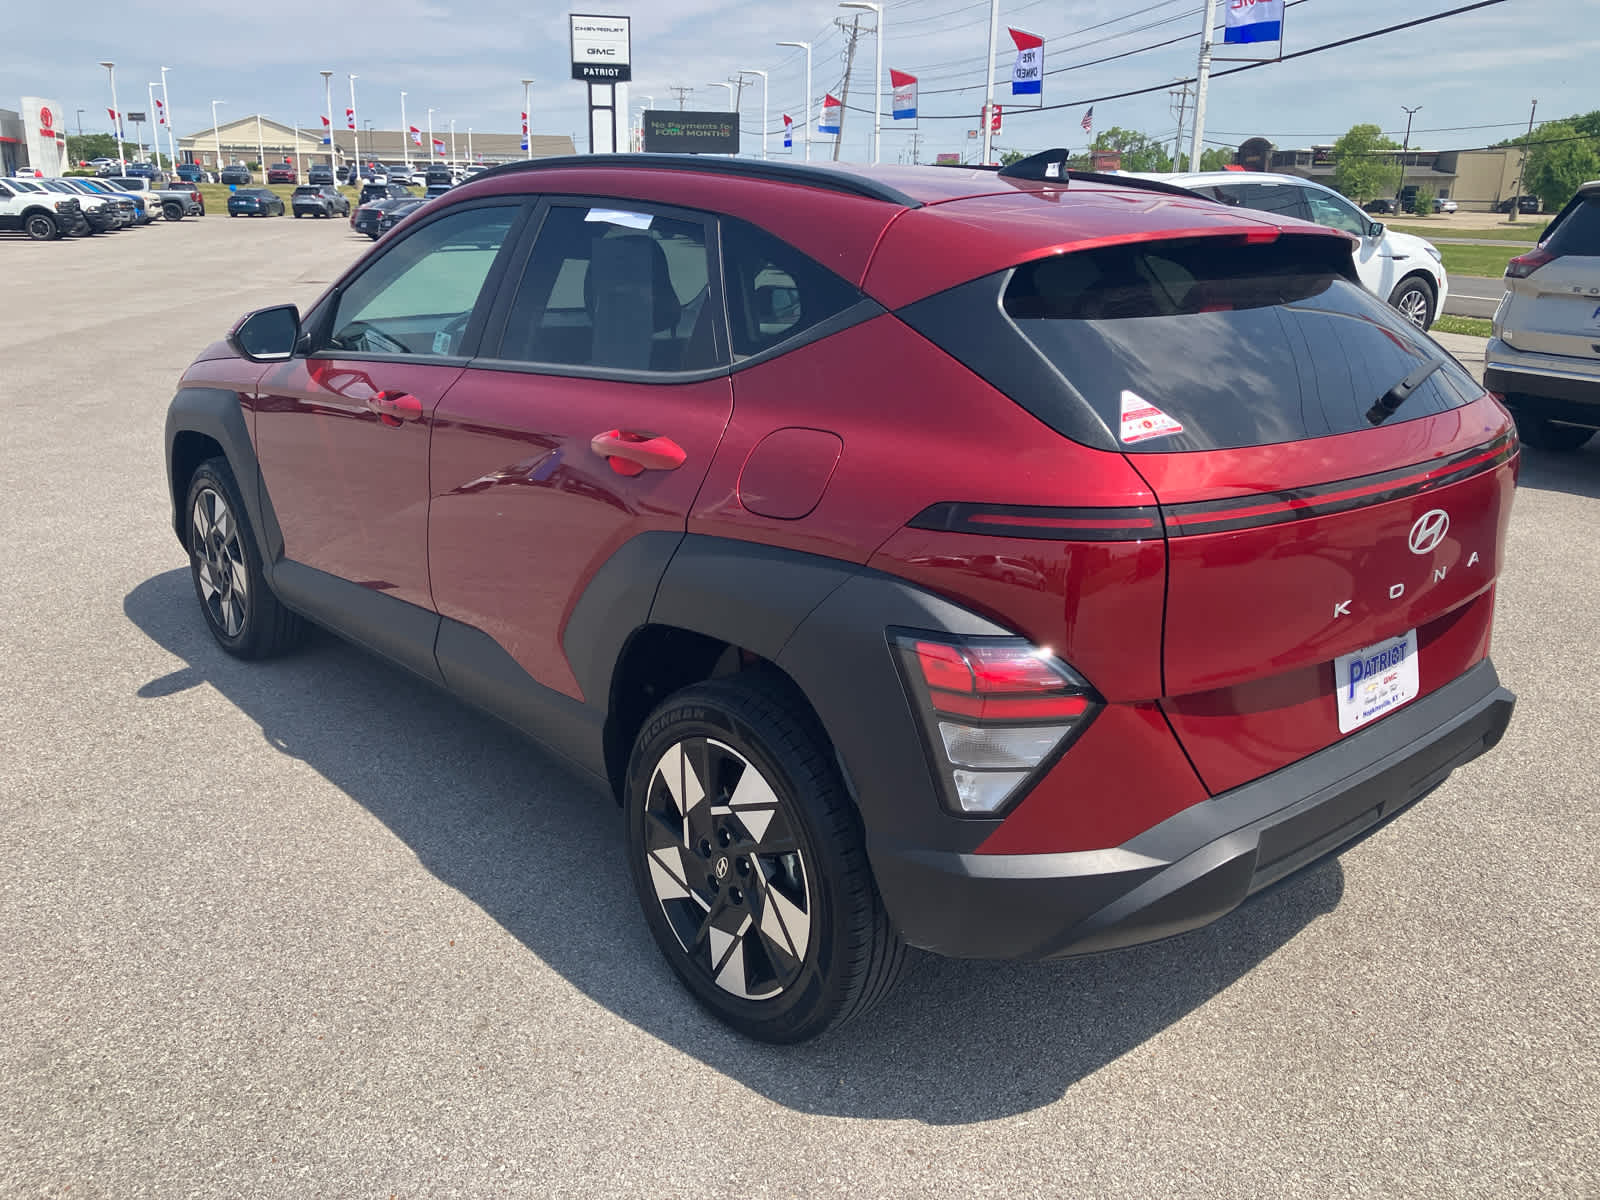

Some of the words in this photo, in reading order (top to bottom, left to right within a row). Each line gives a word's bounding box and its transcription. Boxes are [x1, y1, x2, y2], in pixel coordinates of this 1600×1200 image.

[583, 67, 619, 77] PATRIOT
[667, 121, 718, 130] Payments
[655, 128, 684, 136] FOUR
[686, 129, 731, 137] MONTHS
[1333, 551, 1480, 619] KONA
[1349, 641, 1407, 700] PATRIOT
